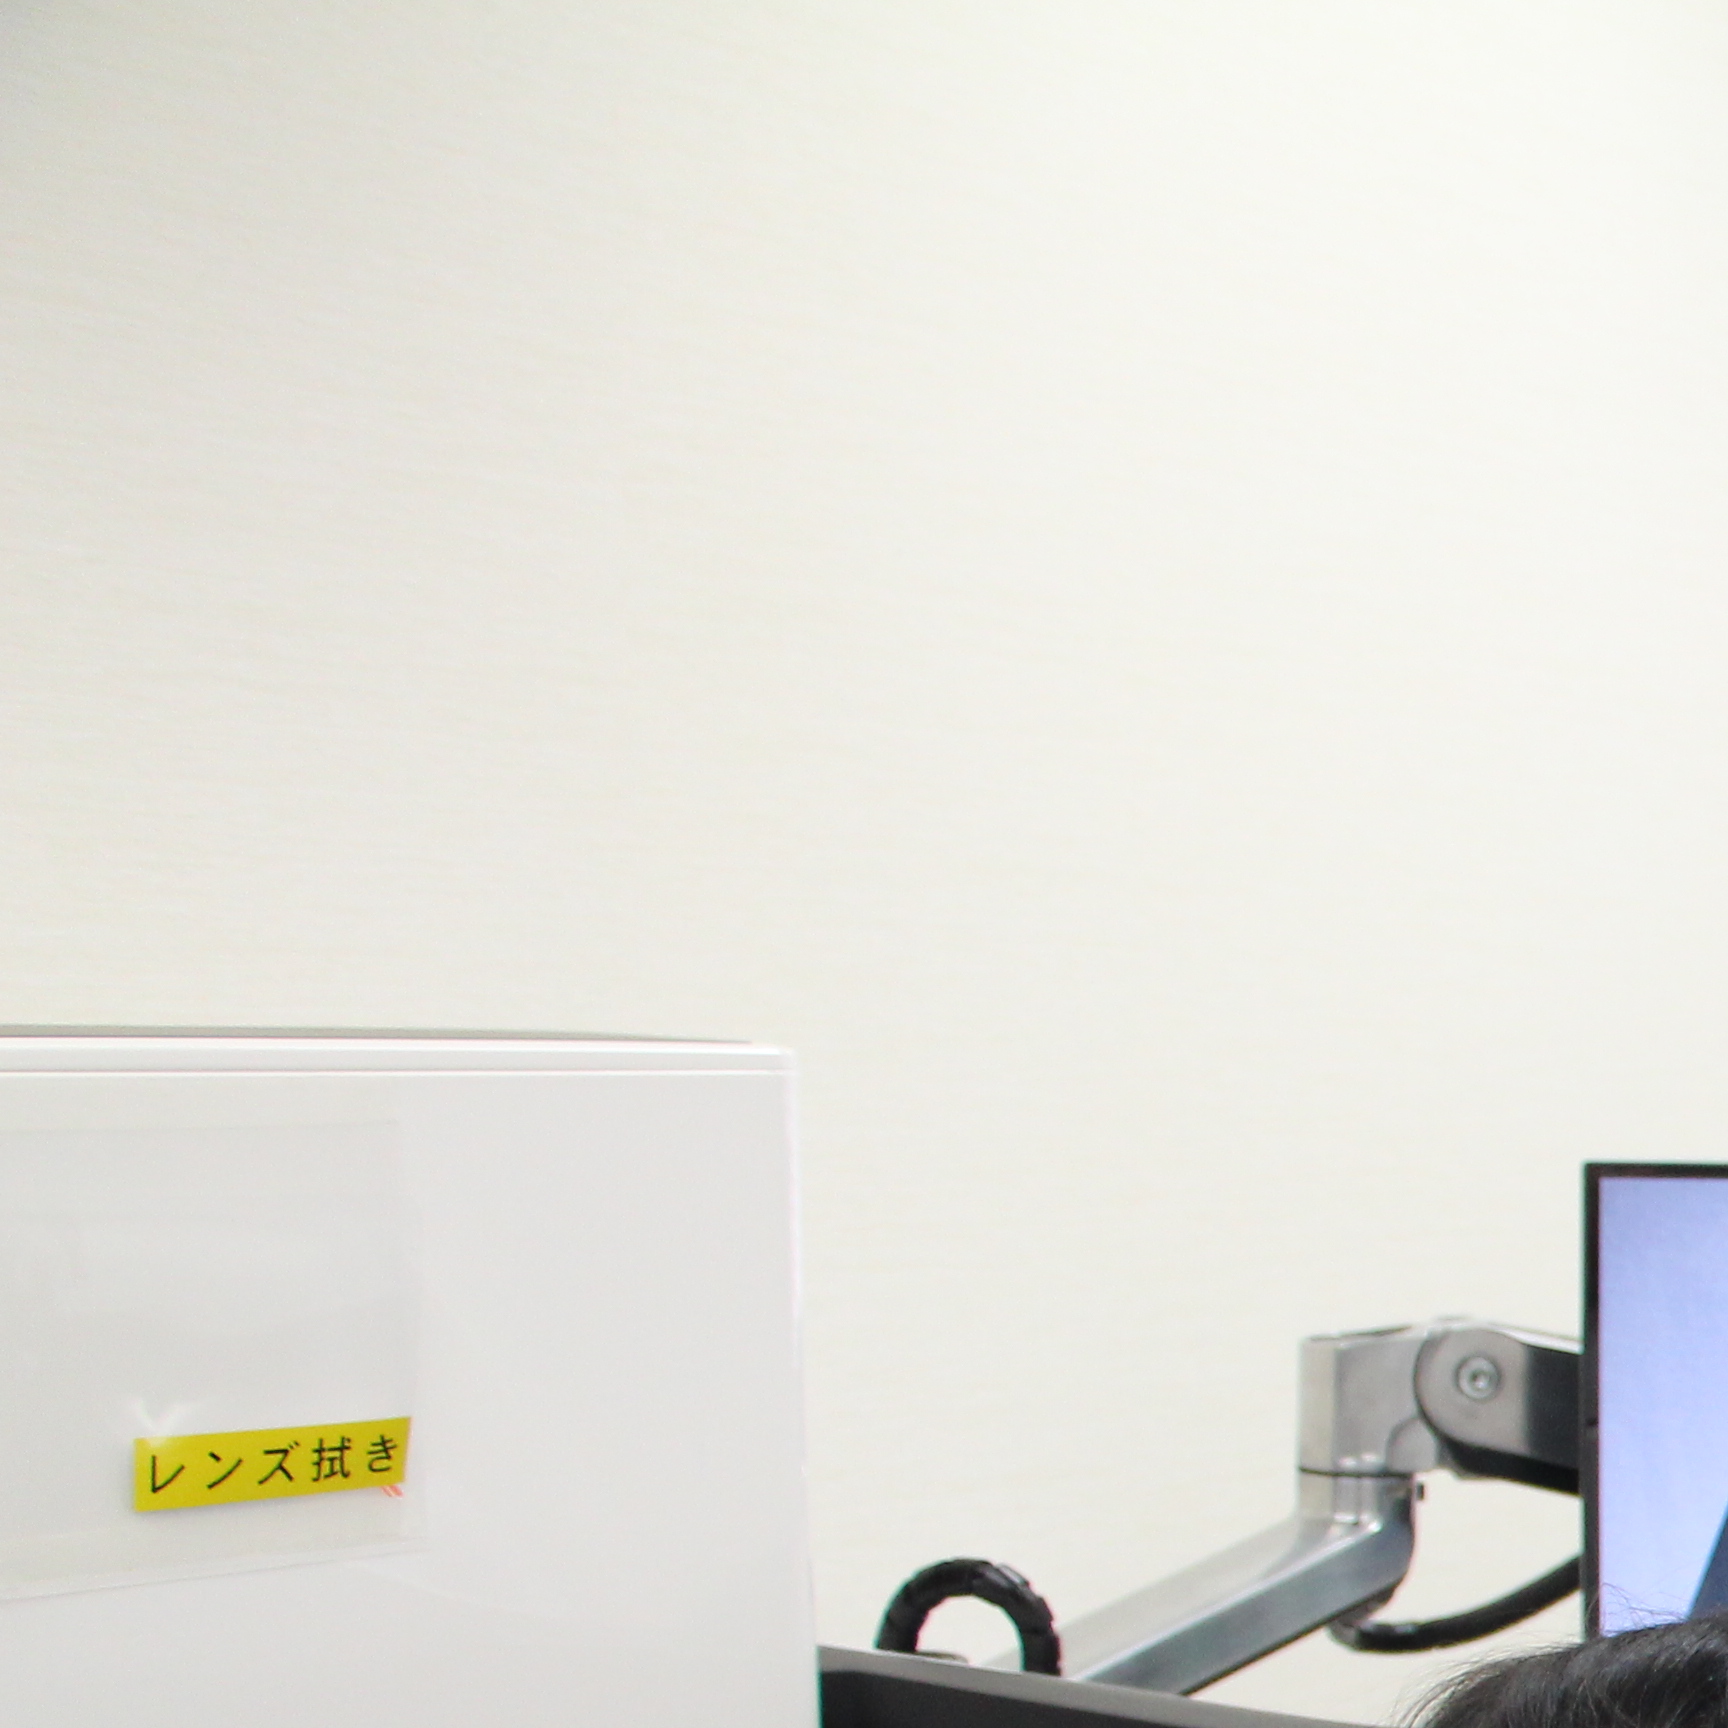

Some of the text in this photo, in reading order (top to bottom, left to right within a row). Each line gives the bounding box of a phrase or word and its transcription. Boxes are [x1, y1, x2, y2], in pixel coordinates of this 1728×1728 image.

[150, 1434, 398, 1494] レンズ拭き
